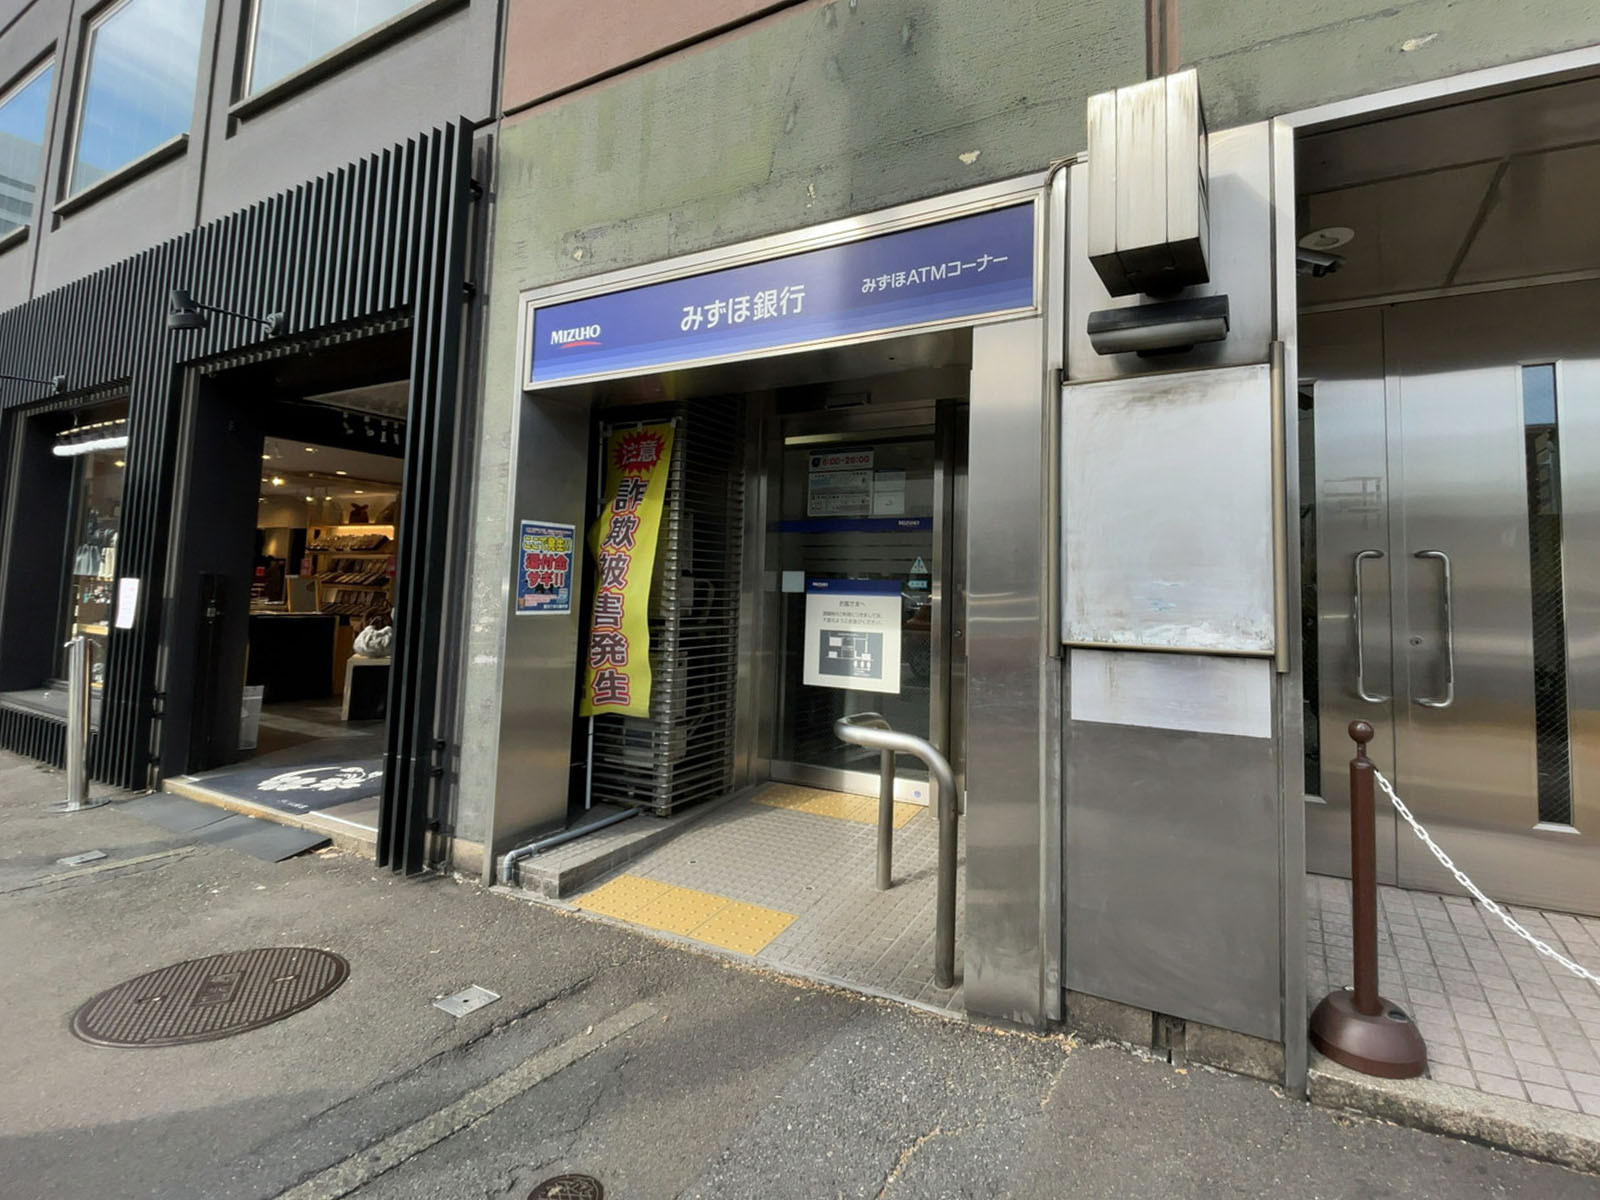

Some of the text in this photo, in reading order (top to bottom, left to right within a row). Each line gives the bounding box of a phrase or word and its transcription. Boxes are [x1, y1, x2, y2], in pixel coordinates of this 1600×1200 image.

[861, 253, 1009, 295] みずほATMコーナー
[680, 285, 806, 333] みずほ銀行
[550, 324, 601, 346] MIZUHO
[621, 439, 658, 465] 注意
[591, 477, 649, 706] 詐欺被害発生
